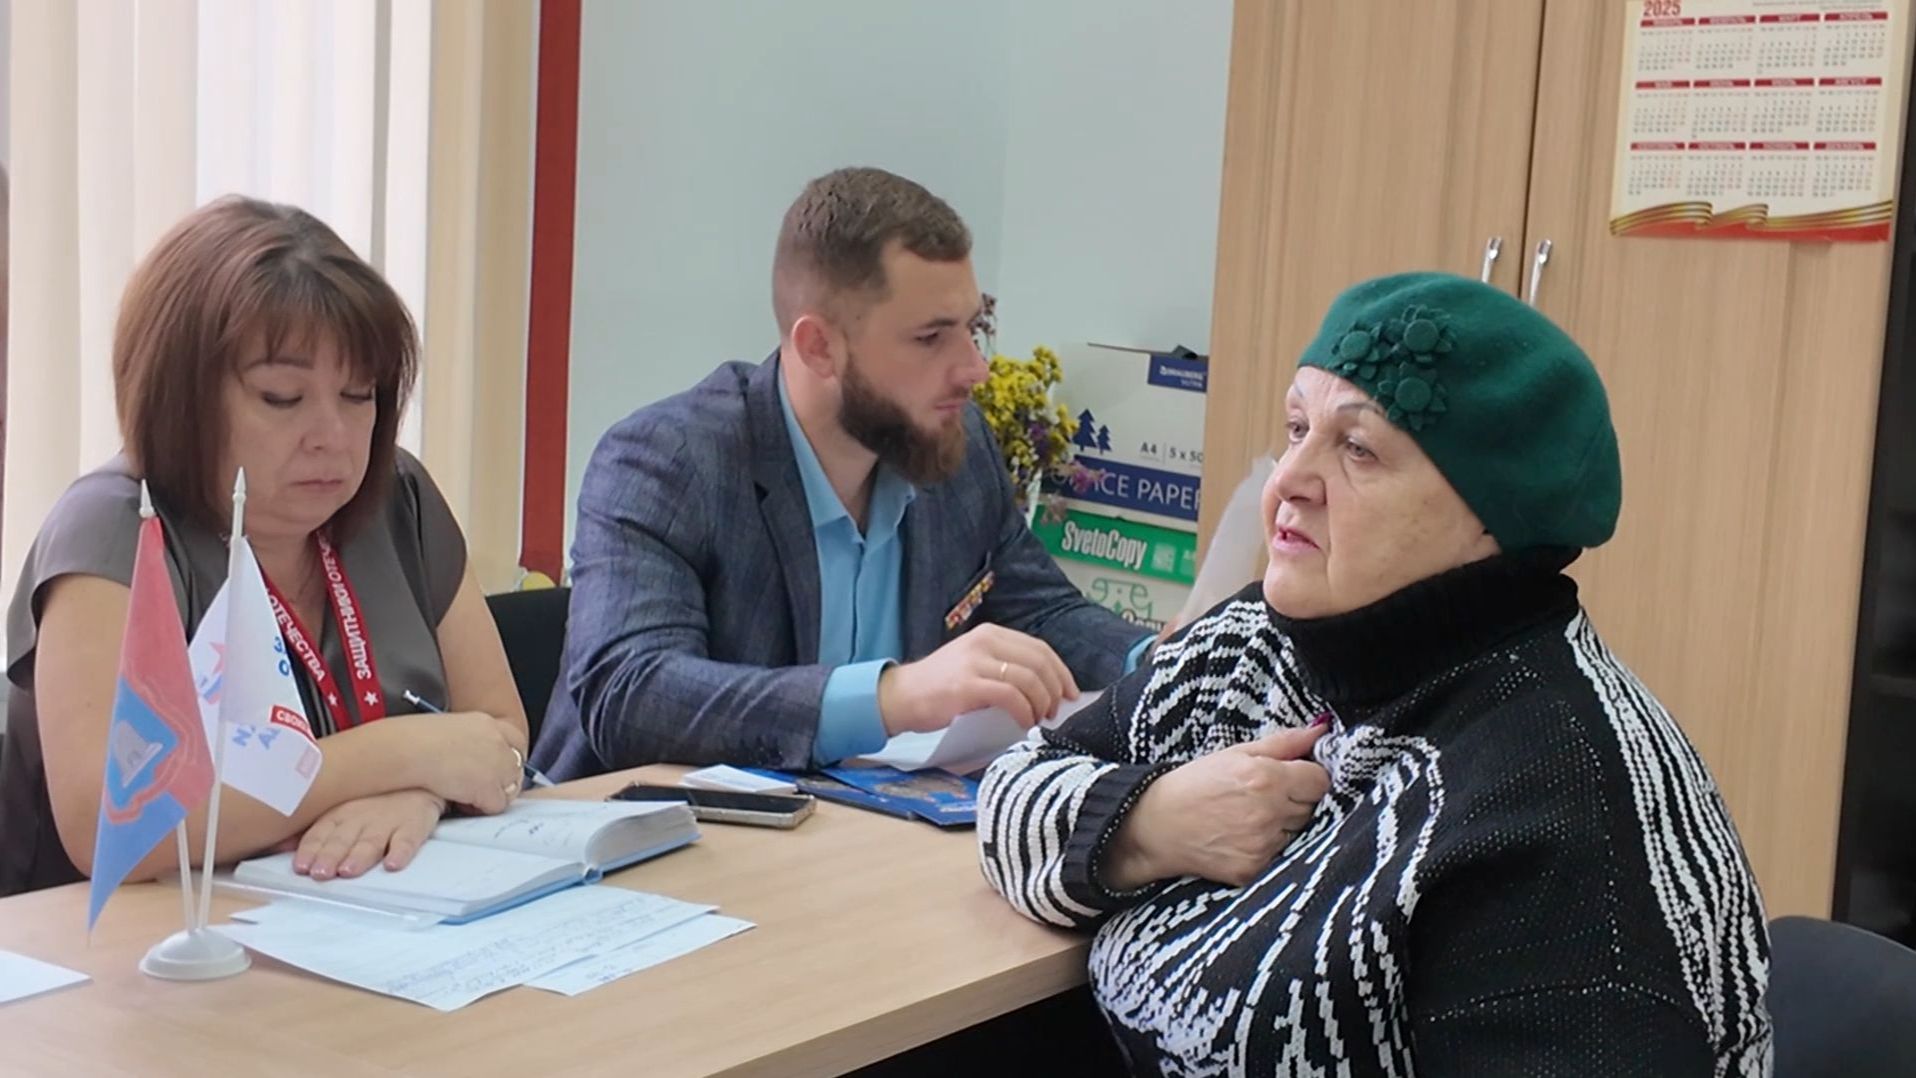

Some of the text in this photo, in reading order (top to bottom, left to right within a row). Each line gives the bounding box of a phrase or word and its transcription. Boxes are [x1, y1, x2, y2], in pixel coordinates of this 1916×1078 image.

[1643, 0, 1681, 17] 2025
[1140, 442, 1157, 455] A4
[1062, 521, 1147, 571] SvetoCopy
[332, 582, 372, 680] ЗАЩИТНИКИ
